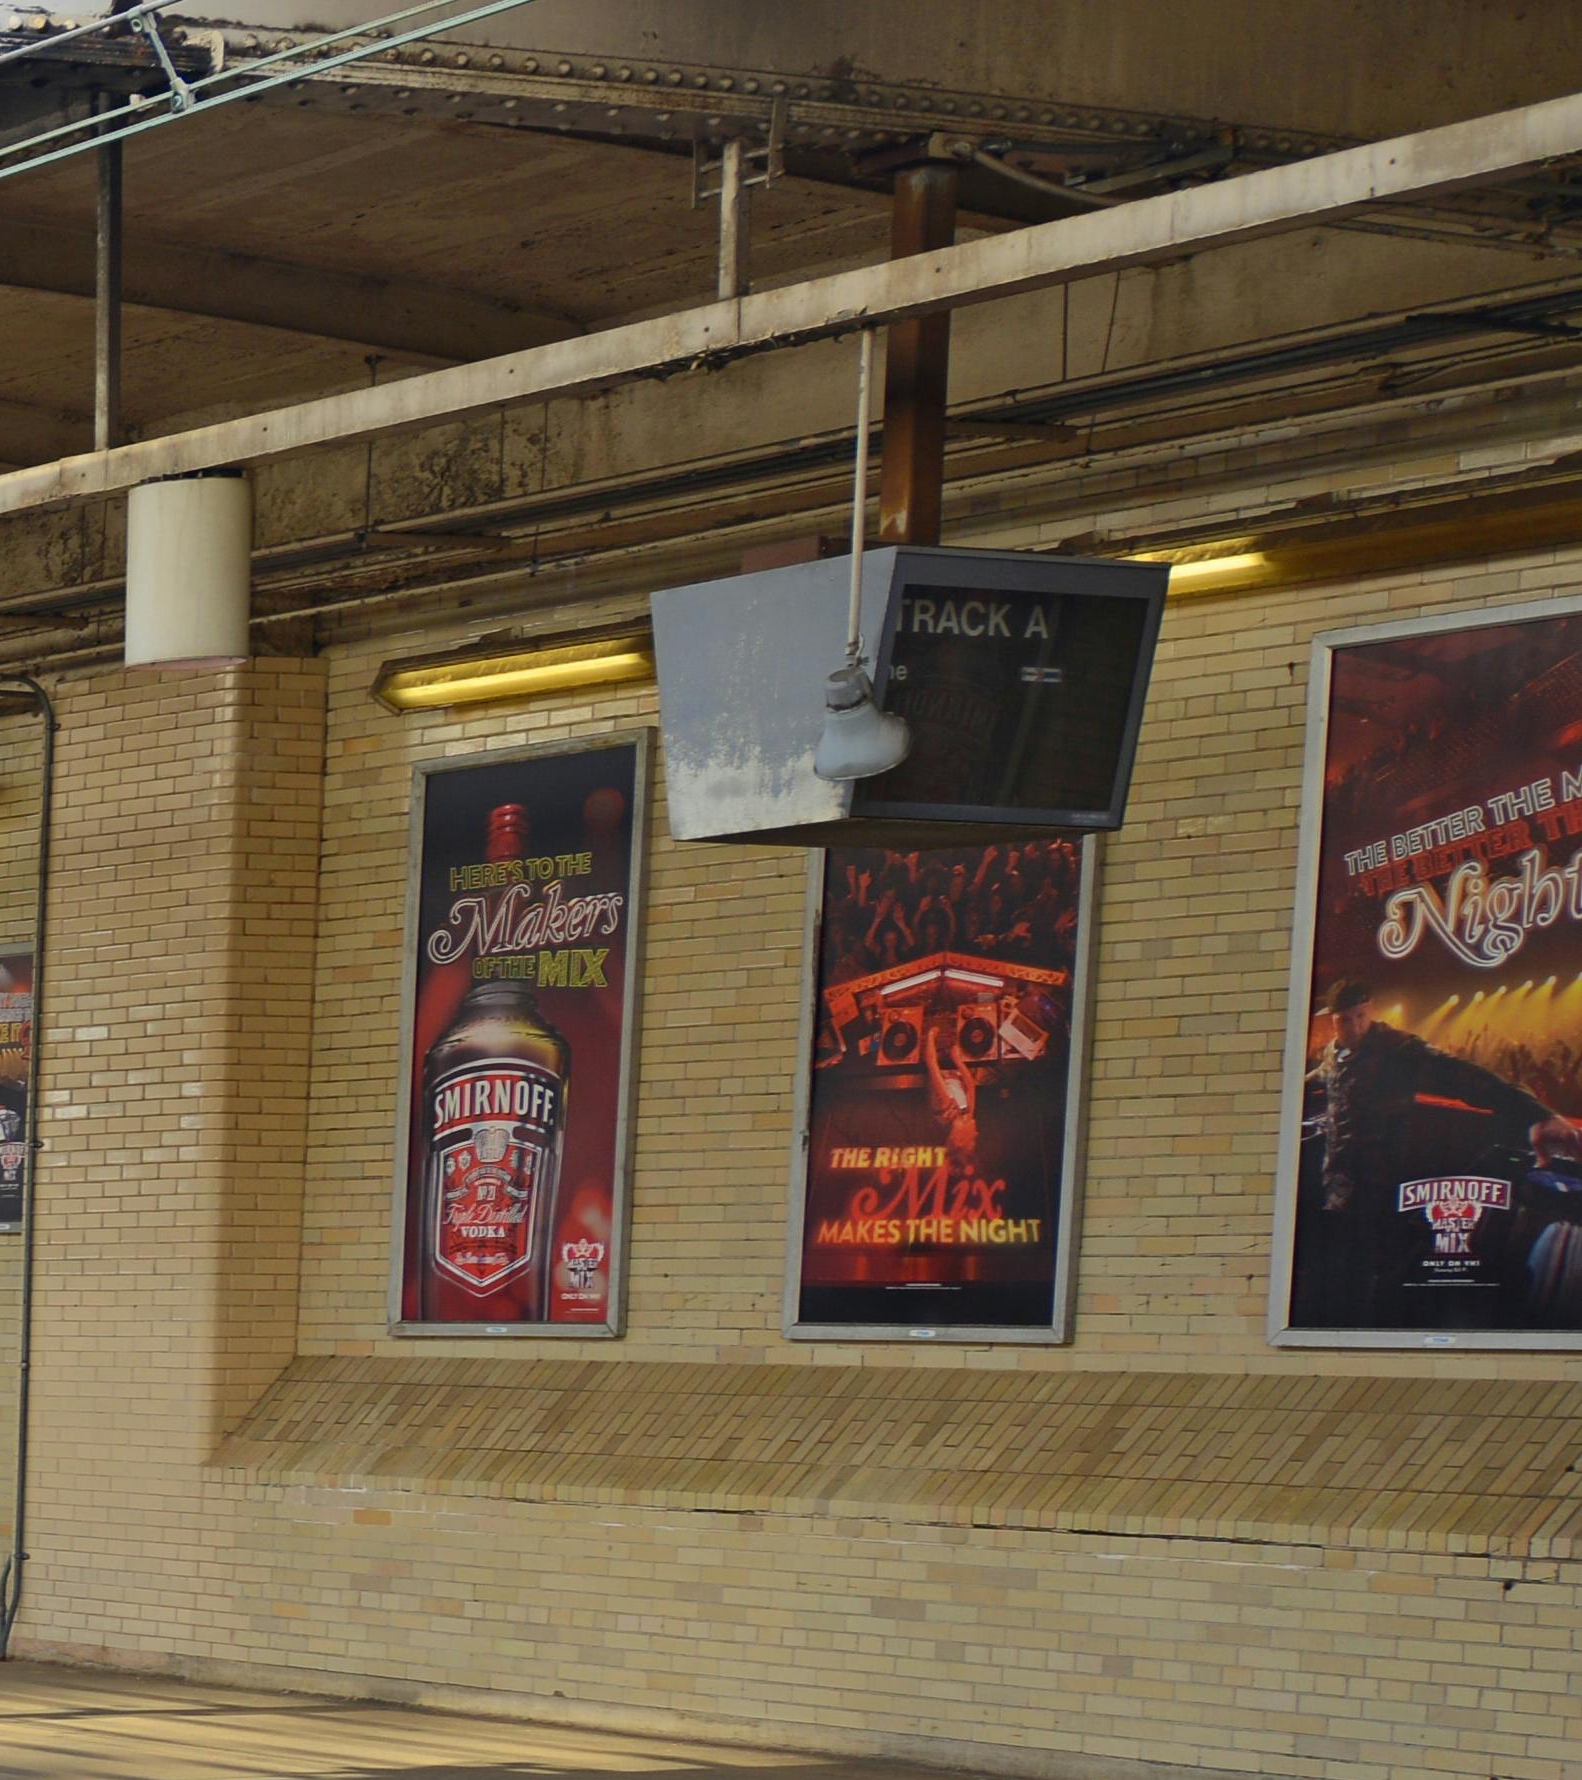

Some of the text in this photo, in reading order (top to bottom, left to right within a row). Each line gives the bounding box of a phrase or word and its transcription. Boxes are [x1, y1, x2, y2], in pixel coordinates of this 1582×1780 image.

[1024, 604, 1049, 639] A
[1344, 840, 1388, 875] THE
[1391, 806, 1485, 860] BETTER
[1488, 778, 1555, 825] THE
[450, 852, 593, 892] HERE'S TO THE
[427, 880, 624, 965] Makers
[472, 948, 610, 988] OF THE MIX
[434, 1079, 555, 1129] SMIRNOFF
[830, 1146, 946, 1169] THE RIGHT
[846, 1160, 1007, 1221] Mix
[1403, 1181, 1503, 1205] SMIRNOFF
[460, 1225, 506, 1238] VODKA
[817, 1219, 1041, 1244] MAKES THE NIGHT
[1435, 1232, 1470, 1254] MIX
